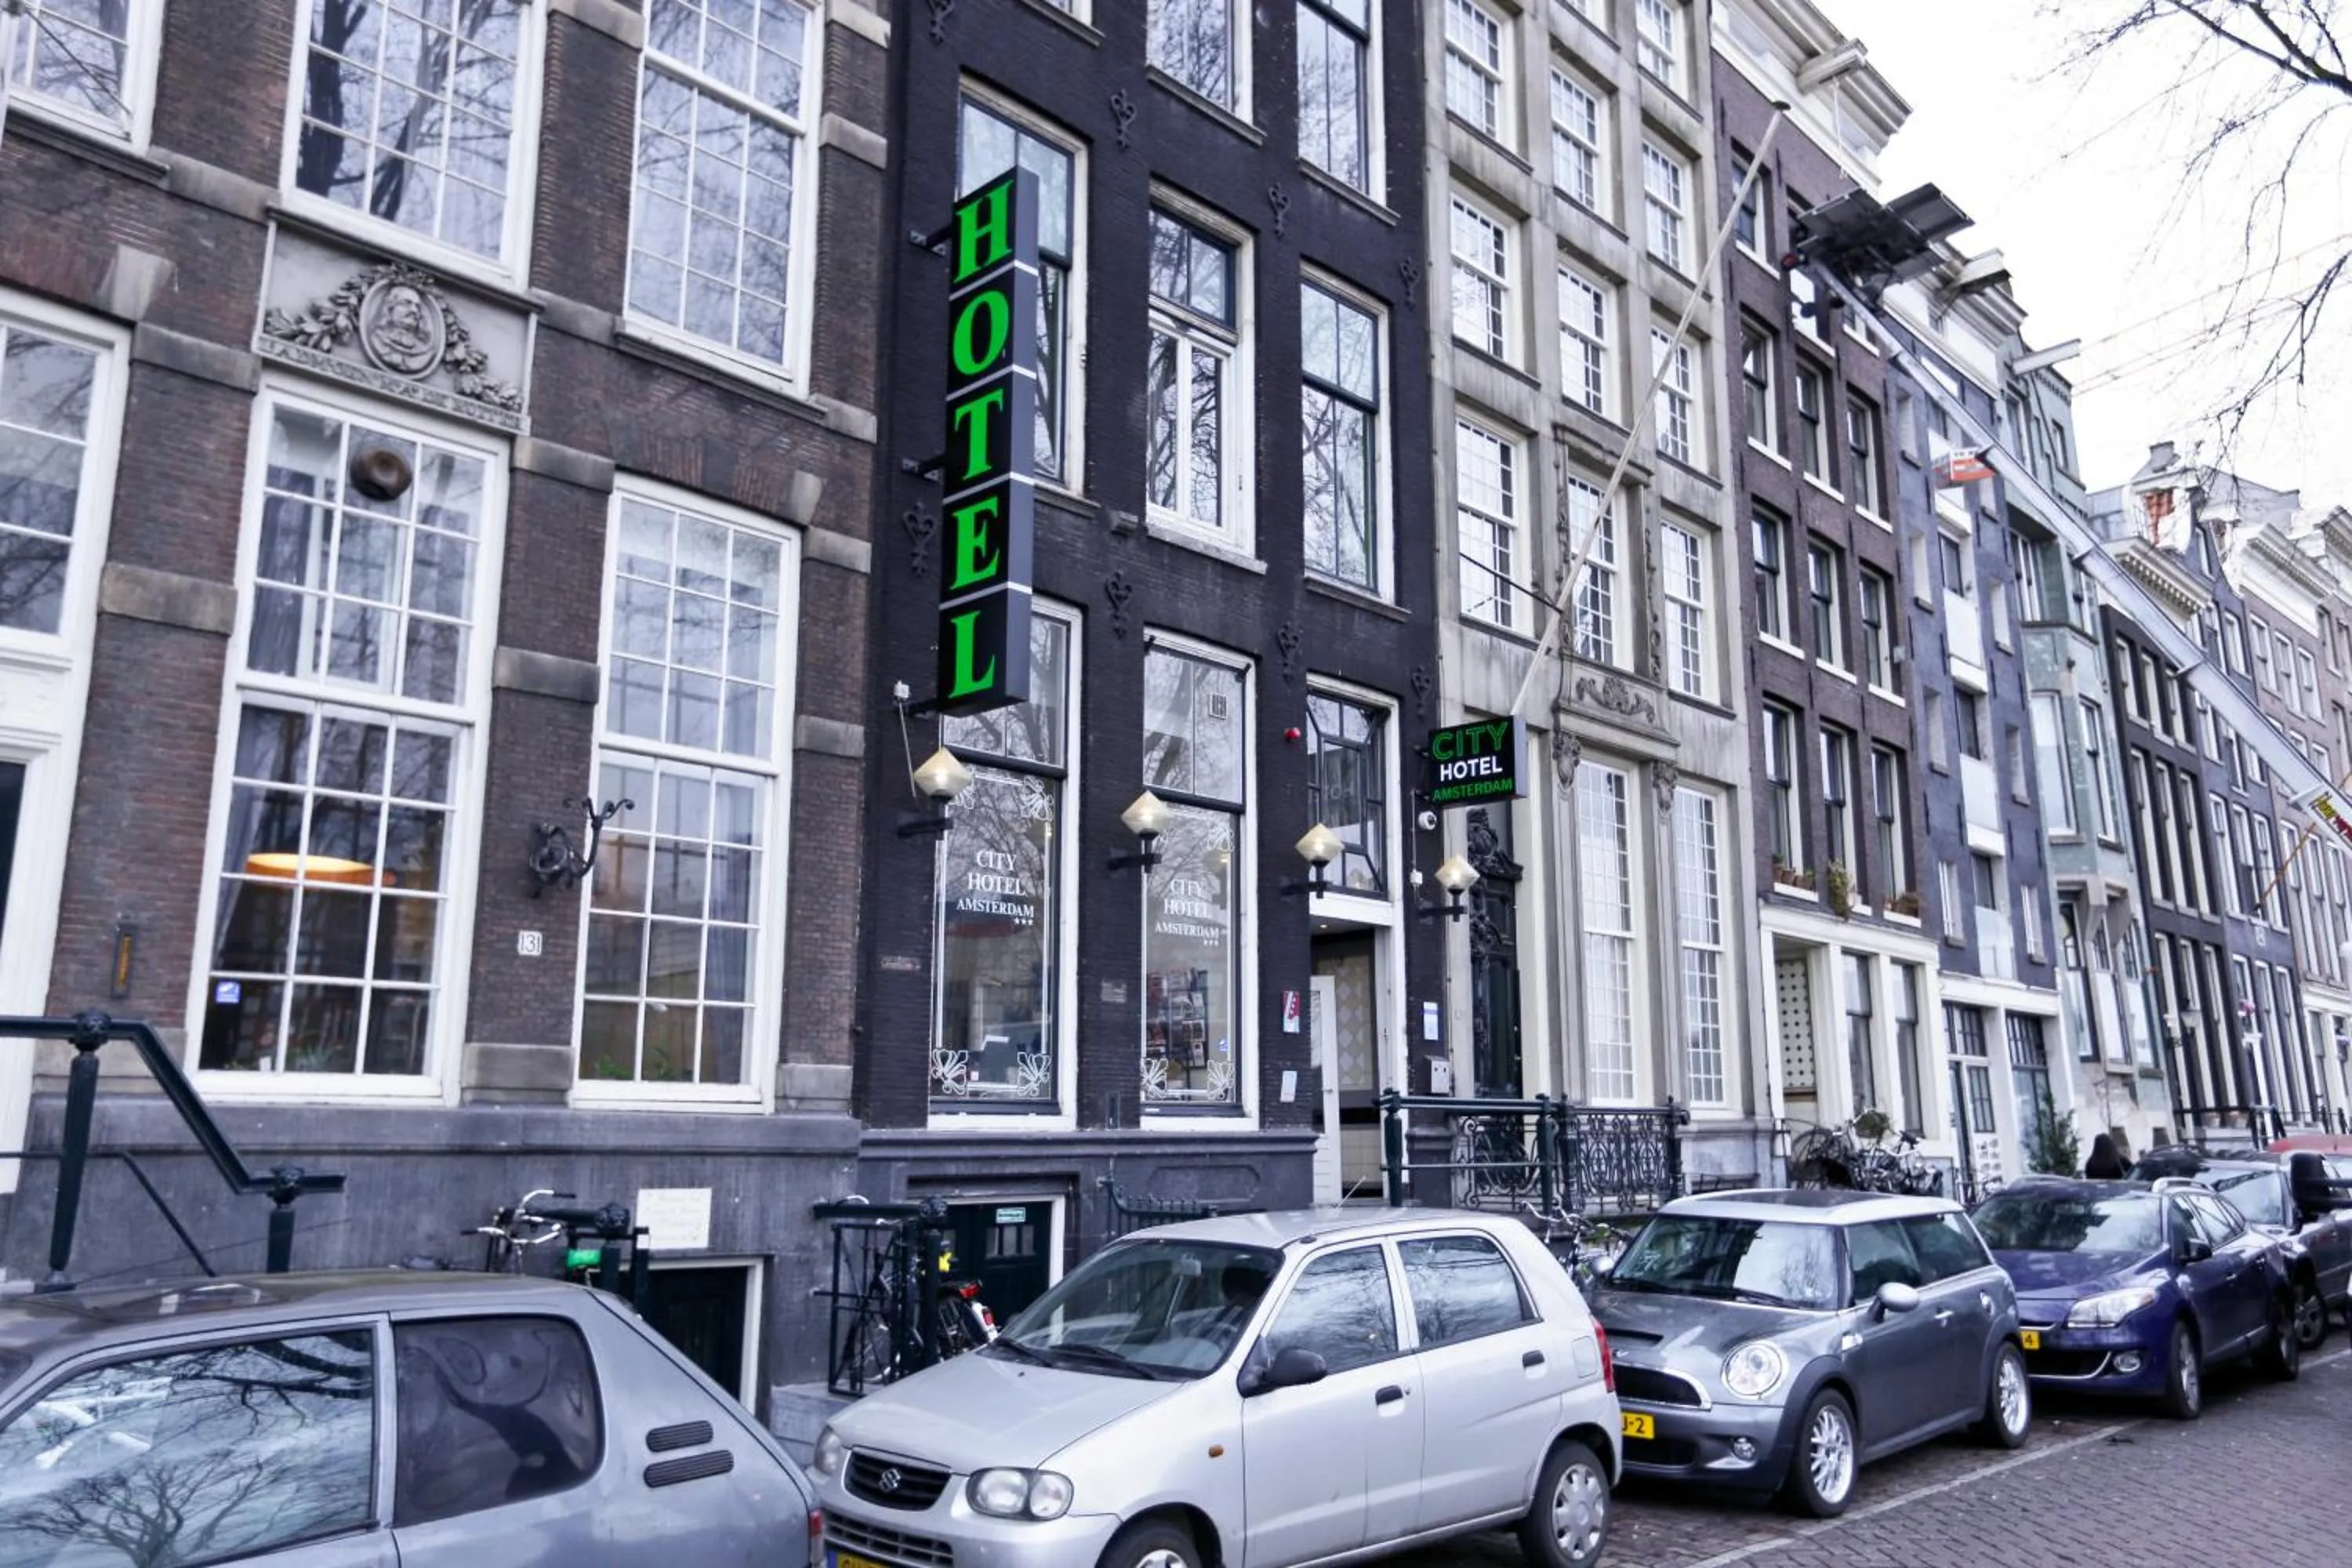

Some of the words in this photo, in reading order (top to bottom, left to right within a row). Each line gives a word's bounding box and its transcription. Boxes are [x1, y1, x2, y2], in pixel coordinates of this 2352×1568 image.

[948, 180, 1014, 699] HOTEL
[1432, 721, 1508, 760] CITY
[1440, 755, 1503, 782] HOTEL
[1433, 778, 1512, 800] AMSTERDAM
[976, 849, 1017, 871] CITY
[967, 872, 1029, 896] HOTEL
[1171, 878, 1204, 897] CITY
[956, 898, 1034, 918] AMSTERDAM
[1164, 898, 1211, 918] HOTEL
[1155, 922, 1219, 938] AMSTERDAM
[520, 934, 541, 953] 131
